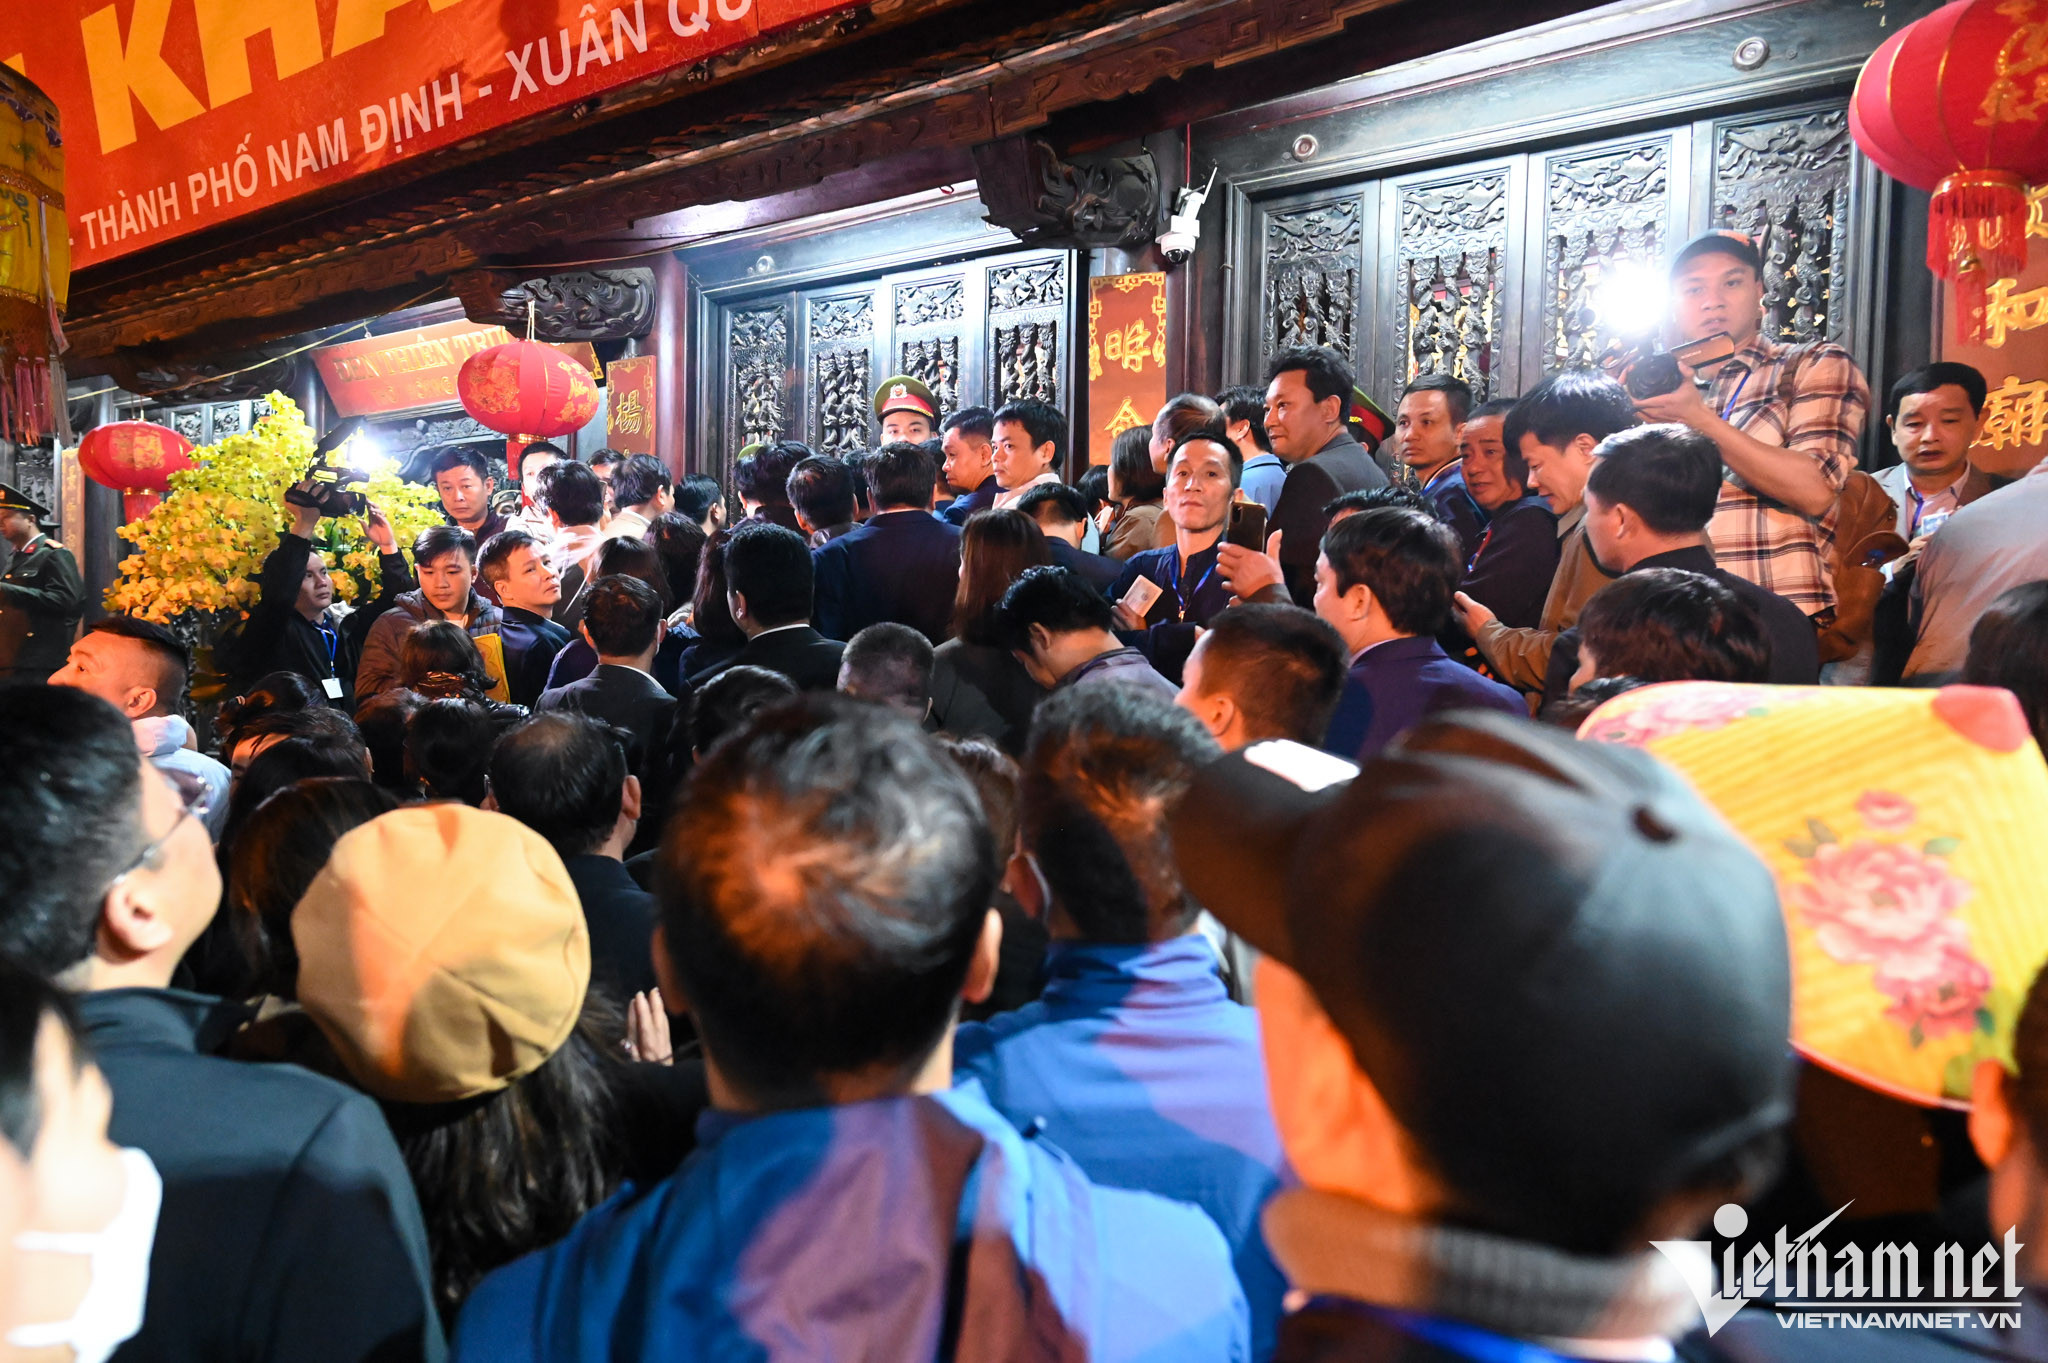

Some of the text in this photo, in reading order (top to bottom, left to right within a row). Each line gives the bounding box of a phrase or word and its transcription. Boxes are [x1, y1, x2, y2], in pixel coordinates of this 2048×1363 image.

[80, 181, 181, 250] THÀNH
[187, 133, 259, 214] PHỐ
[266, 117, 349, 187] NAM
[358, 72, 464, 155] ĐỊNH
[504, 0, 648, 101] XUÂN
[376, 333, 454, 375] THIÊN
